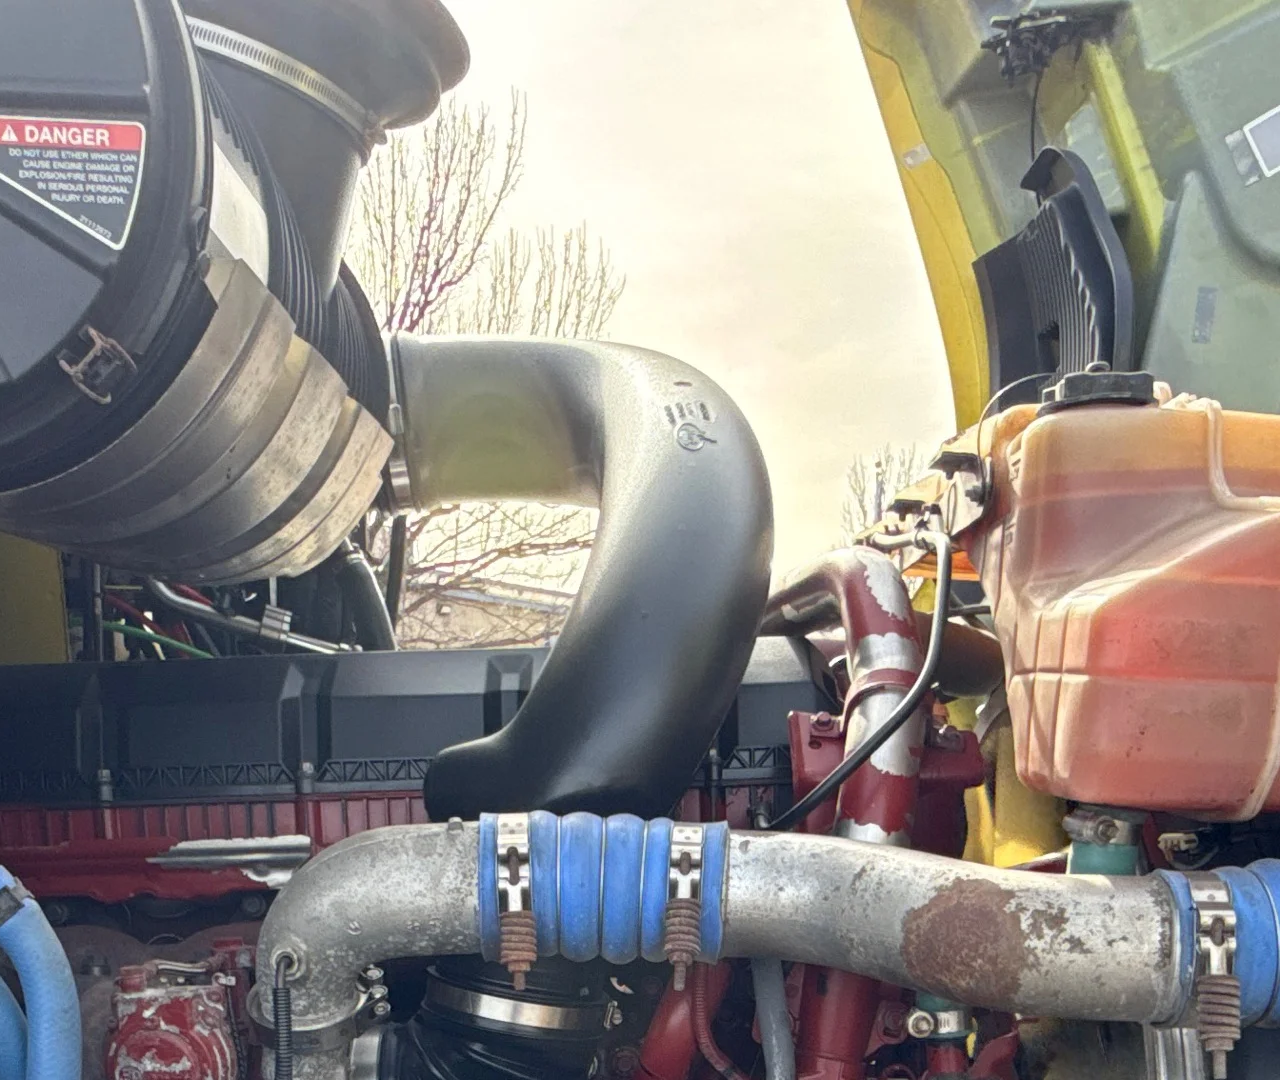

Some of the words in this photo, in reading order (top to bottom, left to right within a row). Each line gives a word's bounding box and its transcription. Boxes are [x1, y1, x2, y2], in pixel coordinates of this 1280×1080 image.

[25, 125, 110, 147] DANGER
[8, 148, 22, 157] DO
[23, 149, 41, 158] NOT
[42, 150, 59, 159] USE
[61, 150, 89, 160] ETHER
[90, 152, 118, 161] WHICH
[119, 153, 138, 162] CAN
[22, 160, 51, 169] CAUSE
[53, 161, 84, 171] ENGINE
[85, 163, 120, 172] DAMAGE
[122, 165, 135, 173] OR
[88, 173, 133, 184] RESULTING
[37, 182, 47, 190] IN
[48, 182, 84, 192] SERIOUS
[86, 184, 130, 194] PERSONAL
[51, 193, 81, 202] INJURY
[83, 195, 95, 203] OR
